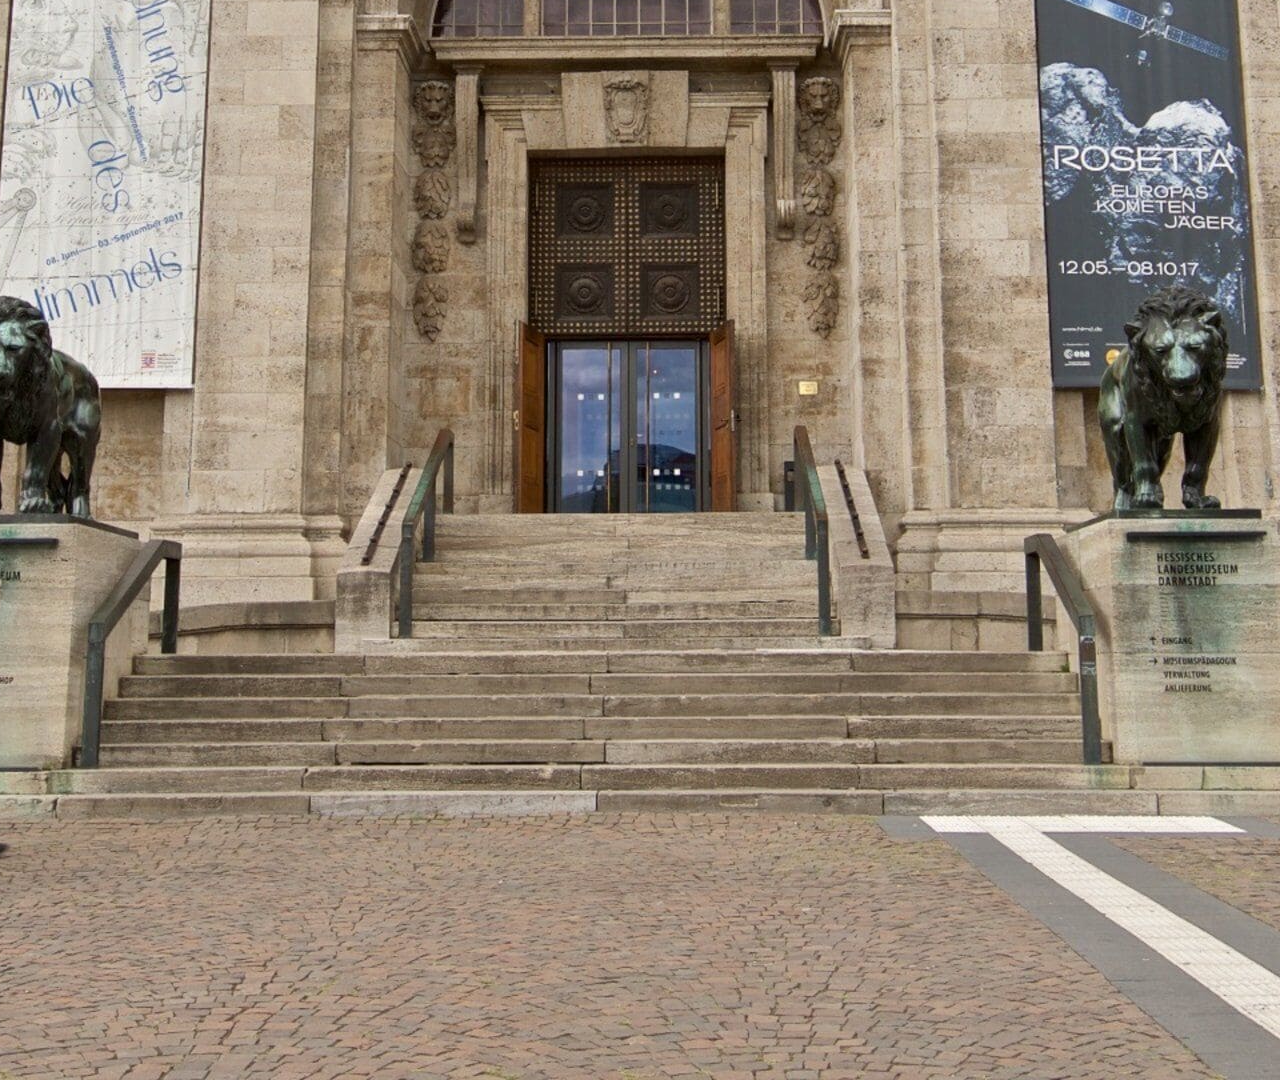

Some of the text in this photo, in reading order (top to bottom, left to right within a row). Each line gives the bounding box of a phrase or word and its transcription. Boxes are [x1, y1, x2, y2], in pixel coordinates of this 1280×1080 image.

[28, 77, 95, 120] Die
[1054, 145, 1235, 173] ROSETTA
[87, 140, 130, 213] des
[1111, 184, 1209, 200] EUROPAS
[1096, 200, 1196, 214] KOMETEN
[111, 220, 161, 242] September
[164, 212, 184, 225] 2017
[1164, 215, 1235, 230] JÄGER
[1157, 552, 1216, 562] HESSISCHES
[1157, 564, 1239, 574] LANDESMUSEUM
[1158, 576, 1218, 586] DARMSTADT
[1161, 636, 1193, 645] EINGANG
[1162, 656, 1237, 665] MUSEUMSPÄDAGOGIK
[1163, 670, 1211, 679] VERWALTUNG
[1165, 684, 1212, 692] ANLIEFERUNG
